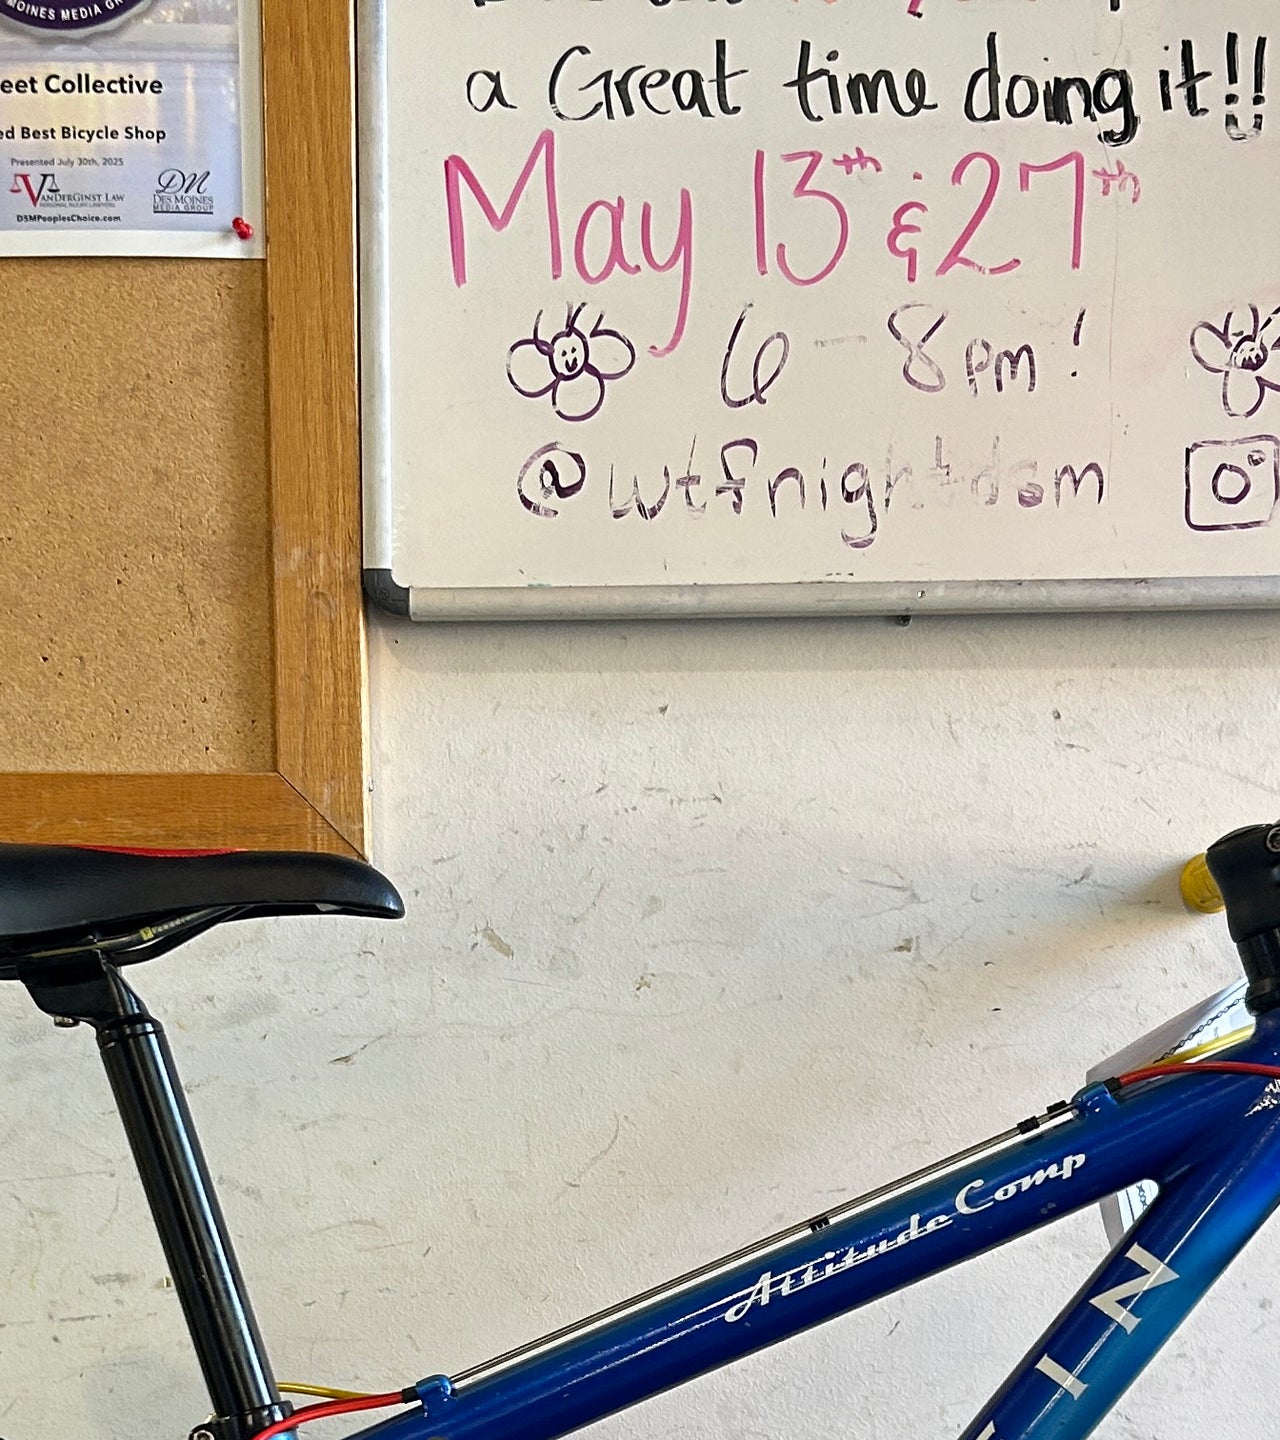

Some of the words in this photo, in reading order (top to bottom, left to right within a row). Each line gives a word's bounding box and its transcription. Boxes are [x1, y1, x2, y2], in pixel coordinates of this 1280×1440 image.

[61, 4, 102, 21] MEDIA
[45, 73, 163, 95] Collective
[466, 71, 516, 112] a
[548, 40, 752, 122] Great
[783, 40, 938, 123] time
[965, 33, 1142, 147] doing
[1157, 33, 1271, 141] it!!
[10, 158, 55, 166] Presented
[57, 158, 75, 168] July
[102, 157, 124, 166] 2025
[21, 126, 57, 141] Best
[62, 125, 119, 144] Bicycle
[125, 126, 167, 144] Shop
[442, 128, 695, 359] May
[751, 146, 884, 288] 13th
[935, 149, 1143, 277] 27th
[720, 301, 790, 408] 6
[725, 1214, 954, 1323] Attitude
[954, 1153, 1087, 1218] Comp
